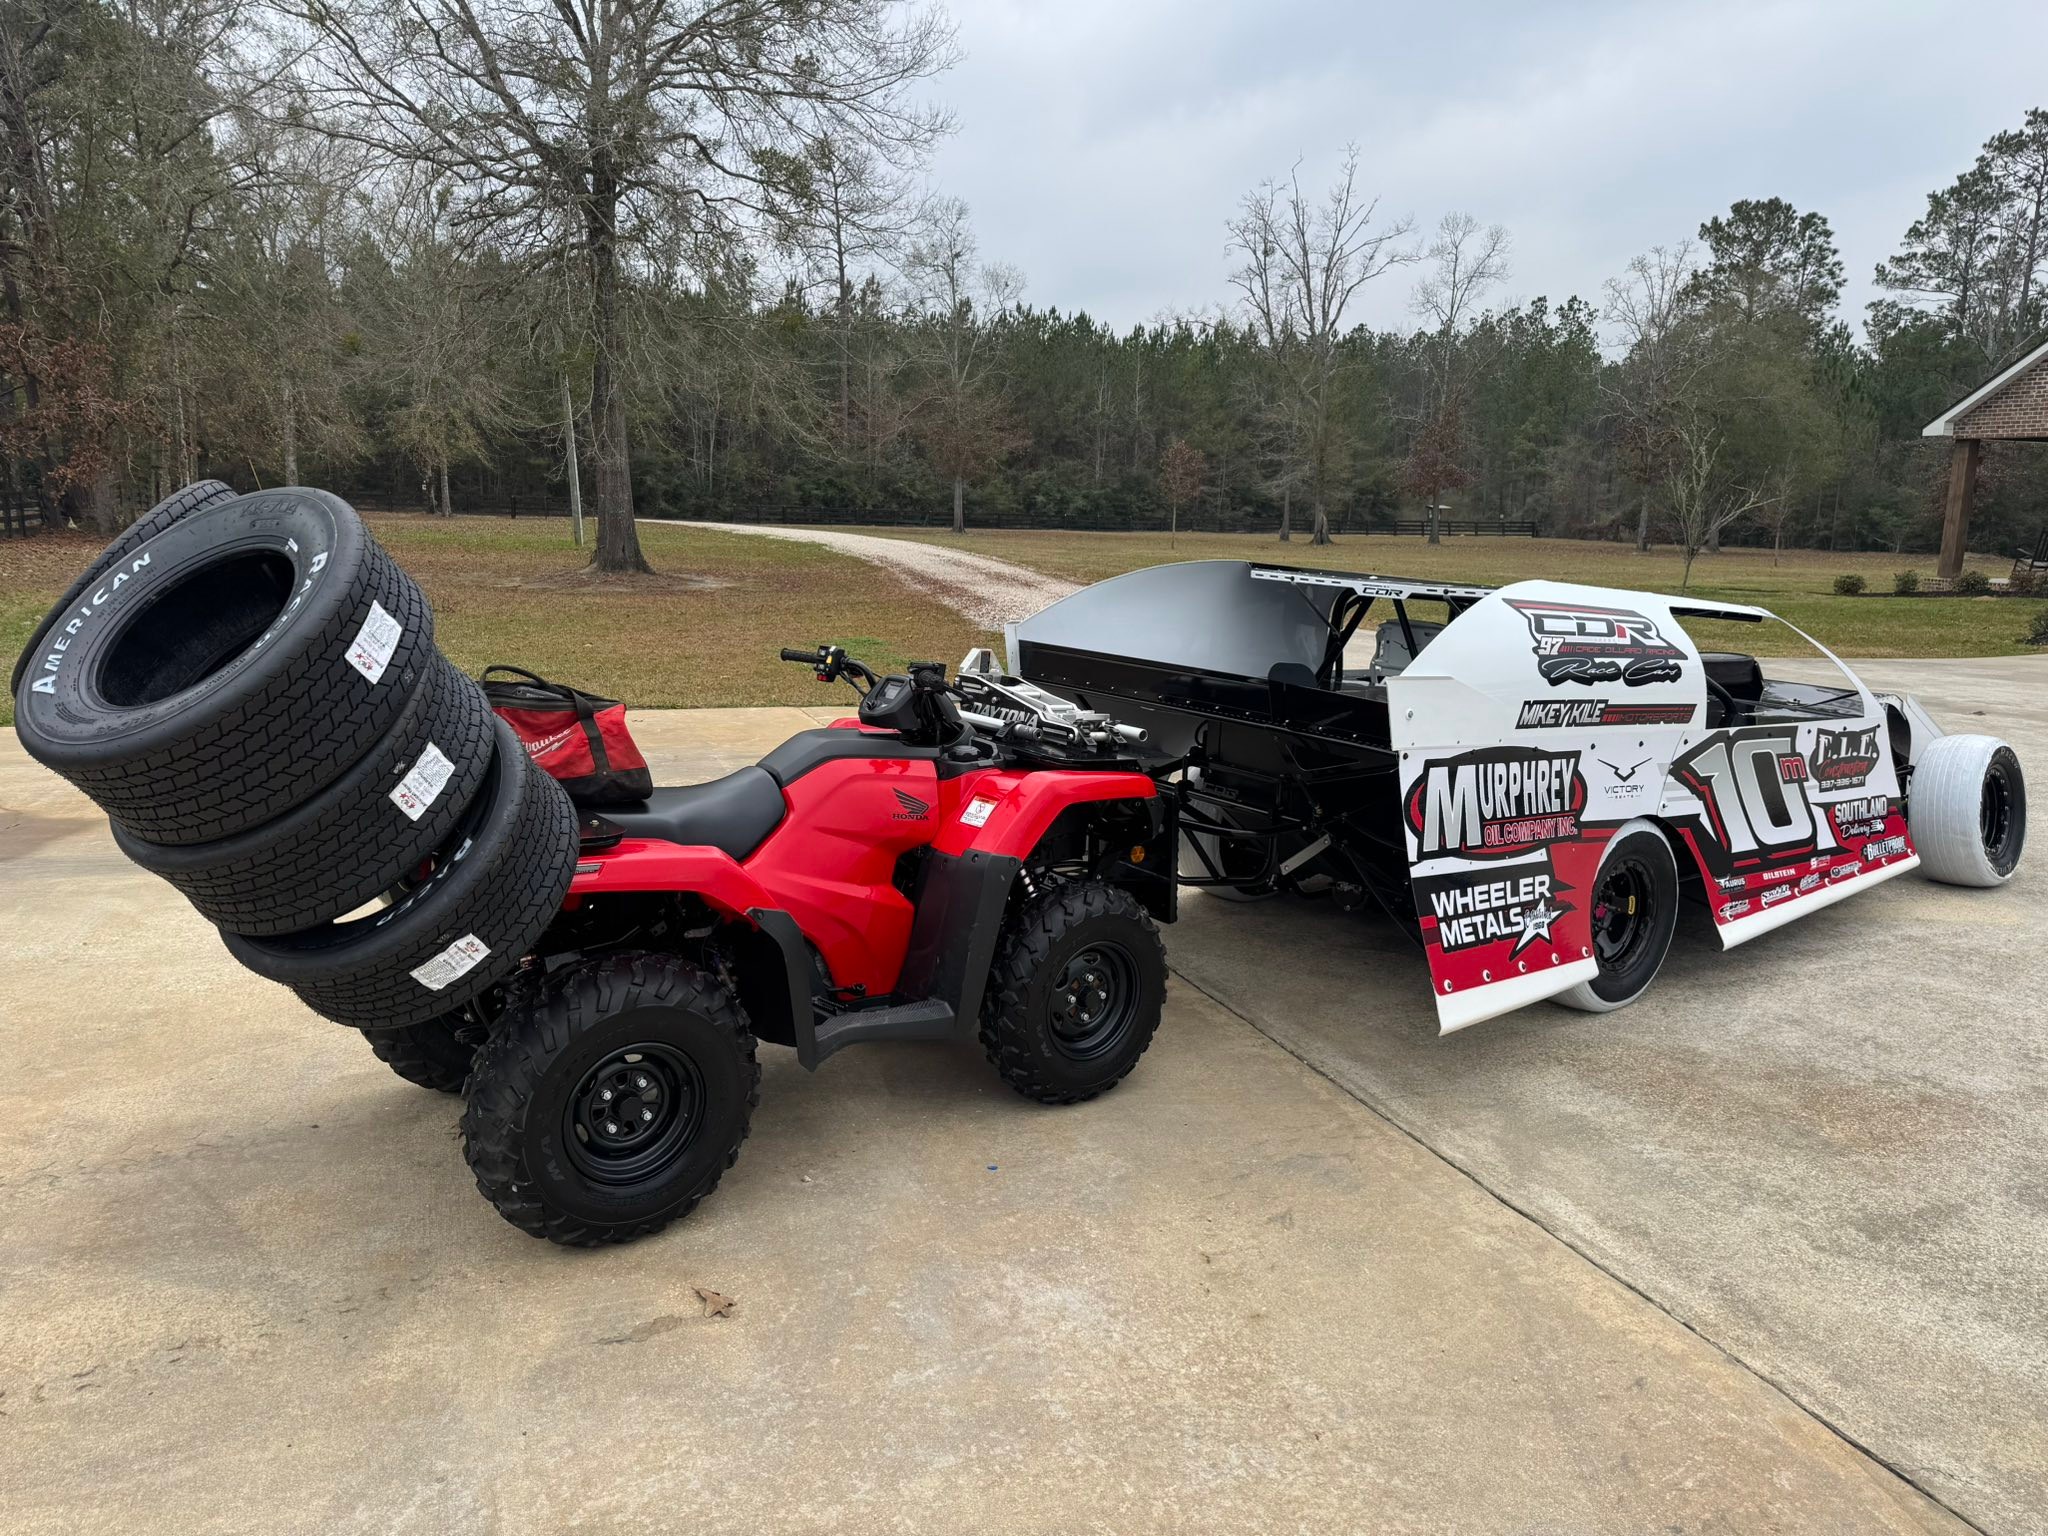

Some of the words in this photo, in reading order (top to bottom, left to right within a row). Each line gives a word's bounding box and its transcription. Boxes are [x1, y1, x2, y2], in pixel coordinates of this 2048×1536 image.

[31, 552, 151, 695] AMERICAN
[1530, 612, 1668, 647] CDR
[1538, 637, 1565, 656] 97
[1541, 657, 1618, 678] Race
[1625, 658, 1679, 679] Cars
[970, 701, 1039, 729] DAYTONA
[1518, 703, 1567, 725] MIKEY
[1568, 702, 1606, 725] KILE
[519, 728, 571, 753] waukee
[1604, 784, 1645, 794] VICTORY
[892, 813, 929, 821] HONDA
[1423, 758, 1576, 852] MURPHREY
[1835, 797, 1887, 824] SOUTHLAND
[1484, 825, 1505, 847] OIL
[1504, 818, 1557, 844] COMPANY
[1556, 816, 1578, 838] INC.
[1840, 821, 1871, 838] Delivery
[1762, 868, 1796, 880] BILSTEIN
[1431, 874, 1552, 918] WHEELER
[1438, 907, 1525, 948] METALS
